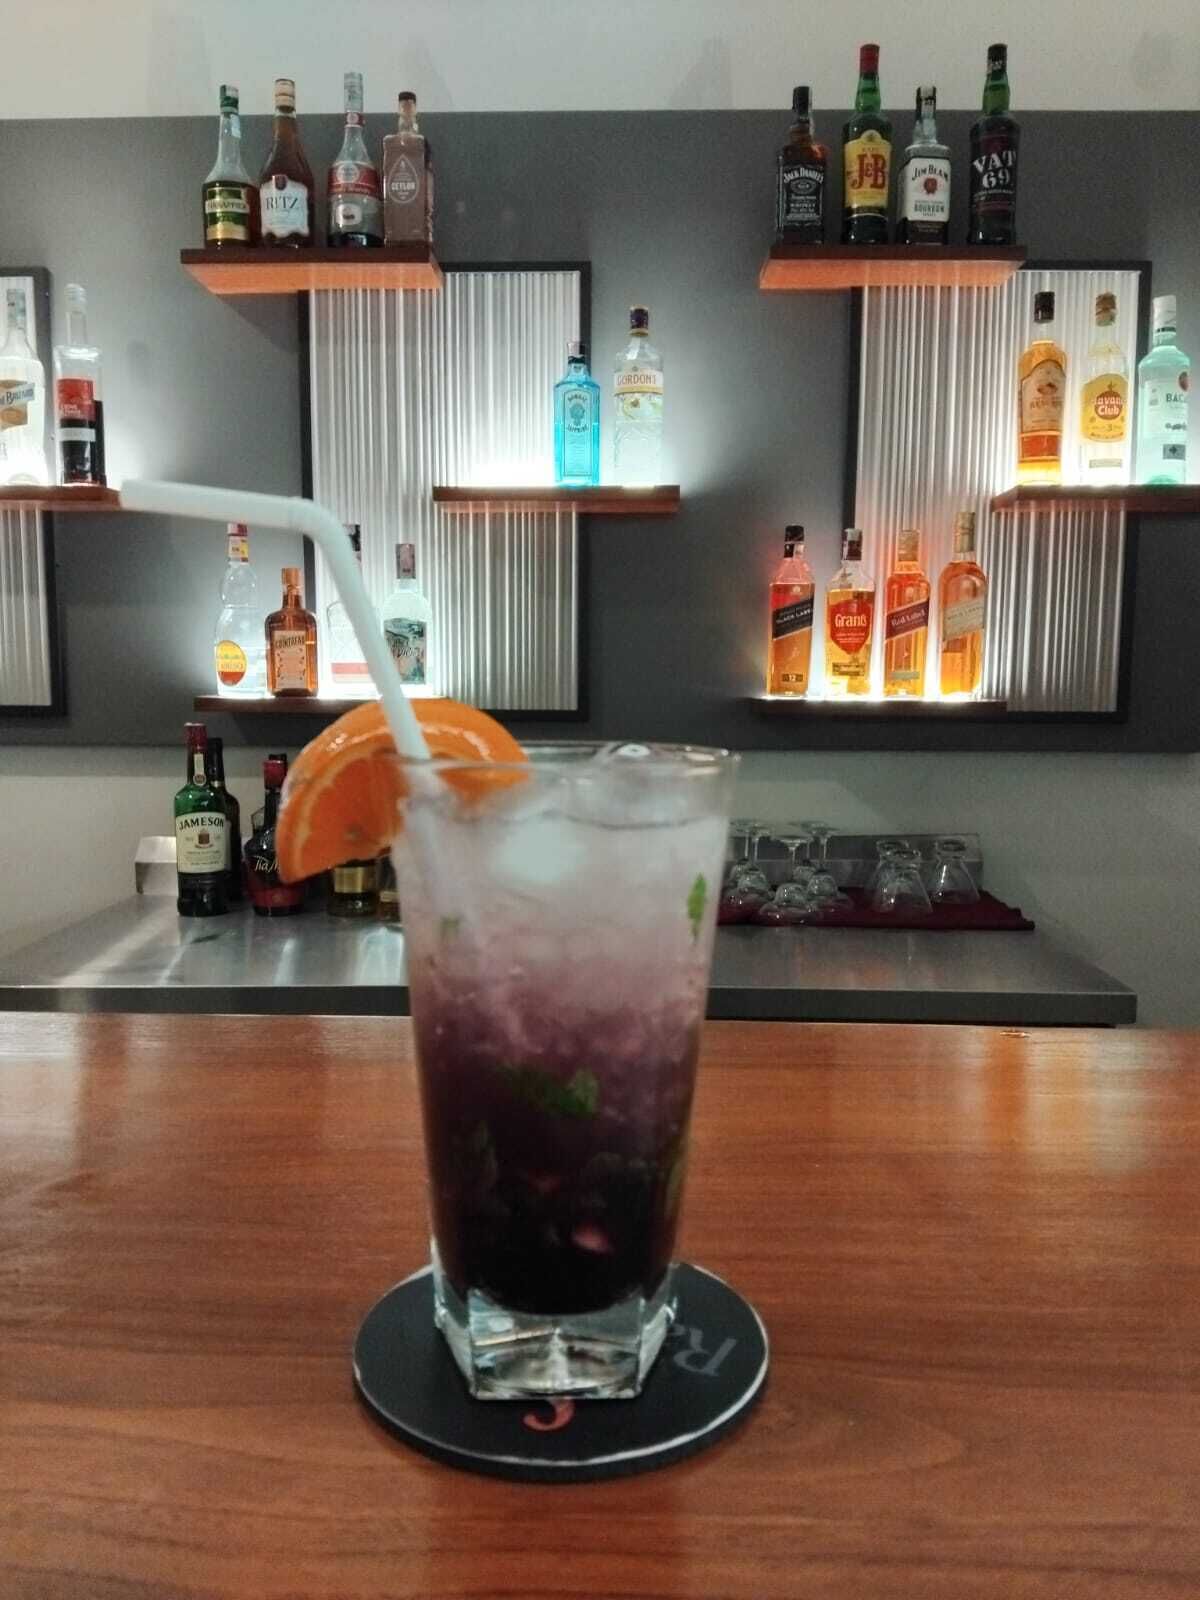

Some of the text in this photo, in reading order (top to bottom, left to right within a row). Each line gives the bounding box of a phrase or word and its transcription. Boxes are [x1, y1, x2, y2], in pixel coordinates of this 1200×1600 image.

[973, 150, 1017, 173] VAT
[849, 153, 887, 190] J&B
[982, 167, 1011, 188] 69
[266, 195, 299, 211] RITZ
[1097, 405, 1119, 416] Club
[179, 816, 225, 831] JAMESON
